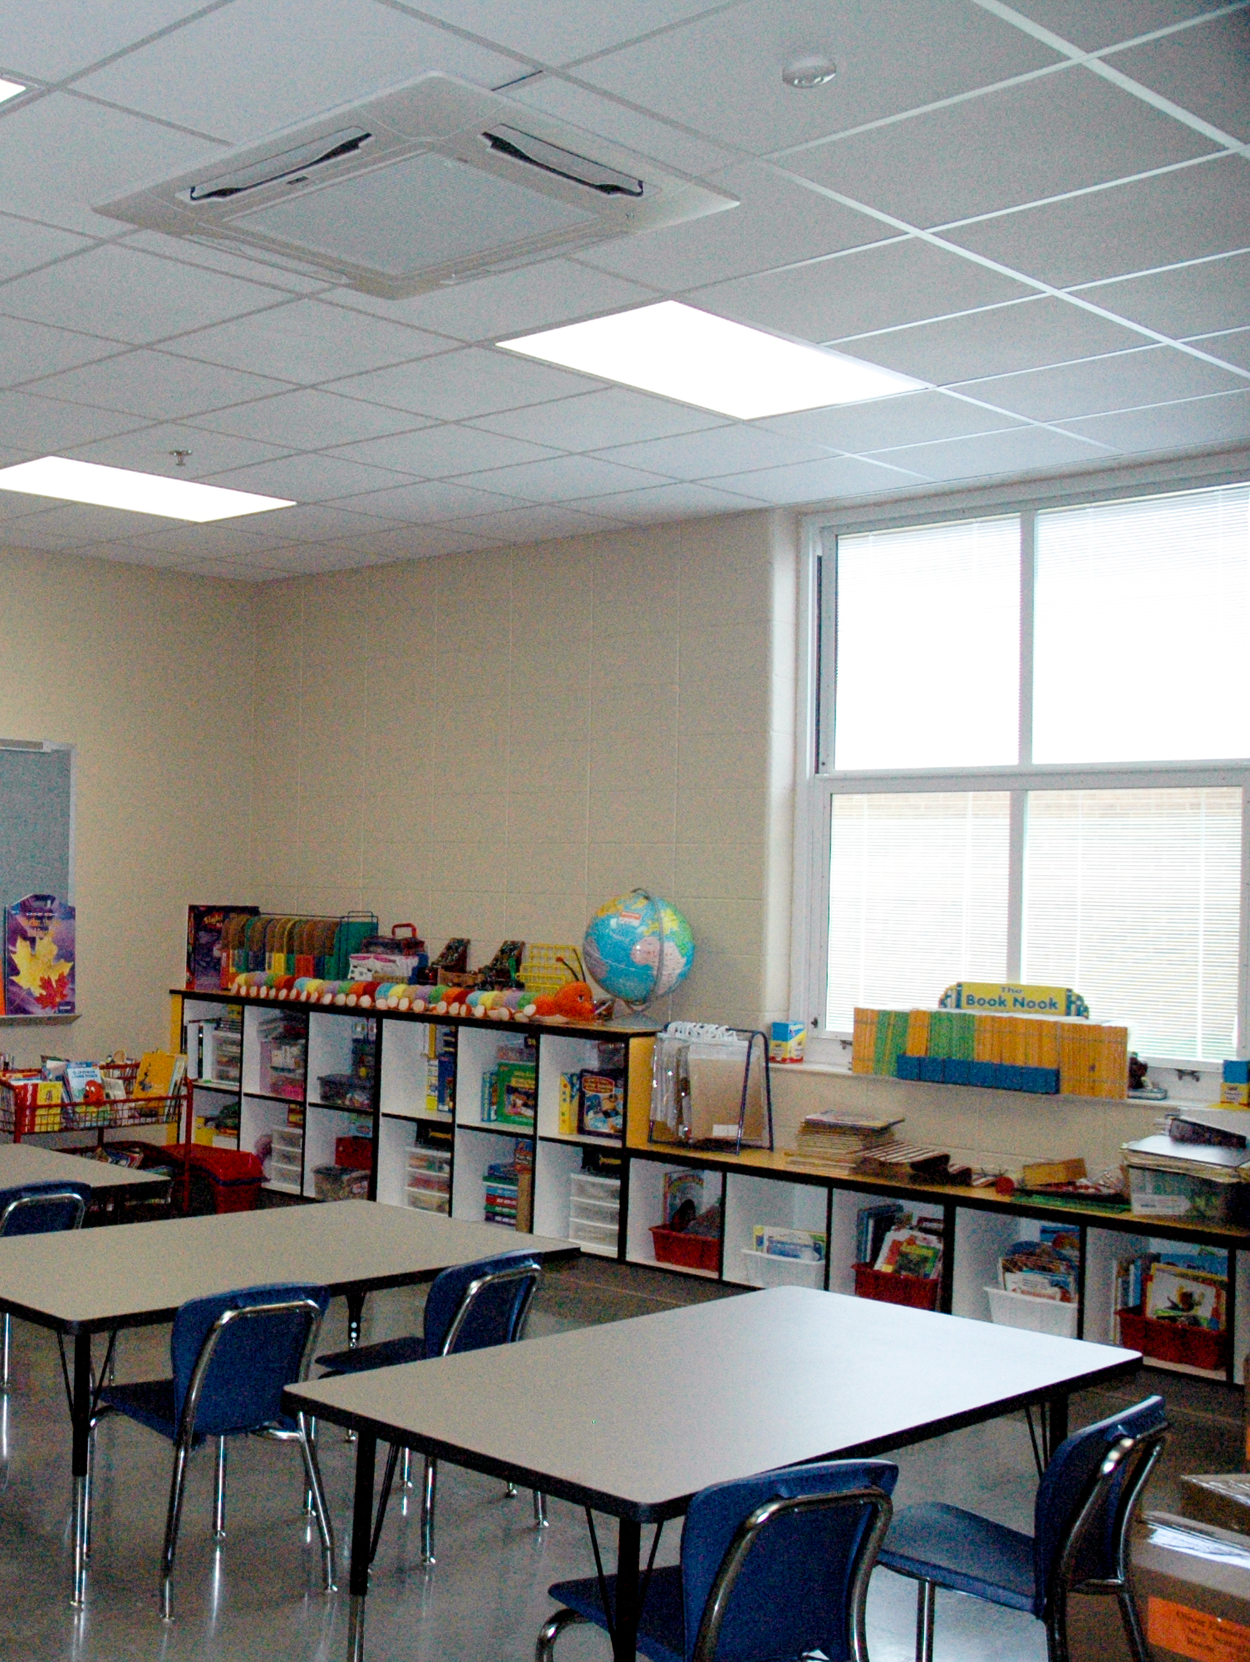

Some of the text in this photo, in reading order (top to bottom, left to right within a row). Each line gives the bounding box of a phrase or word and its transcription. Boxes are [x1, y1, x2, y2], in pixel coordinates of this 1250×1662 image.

[1000, 986, 1023, 995] The
[965, 994, 1059, 1010] Book Nook
